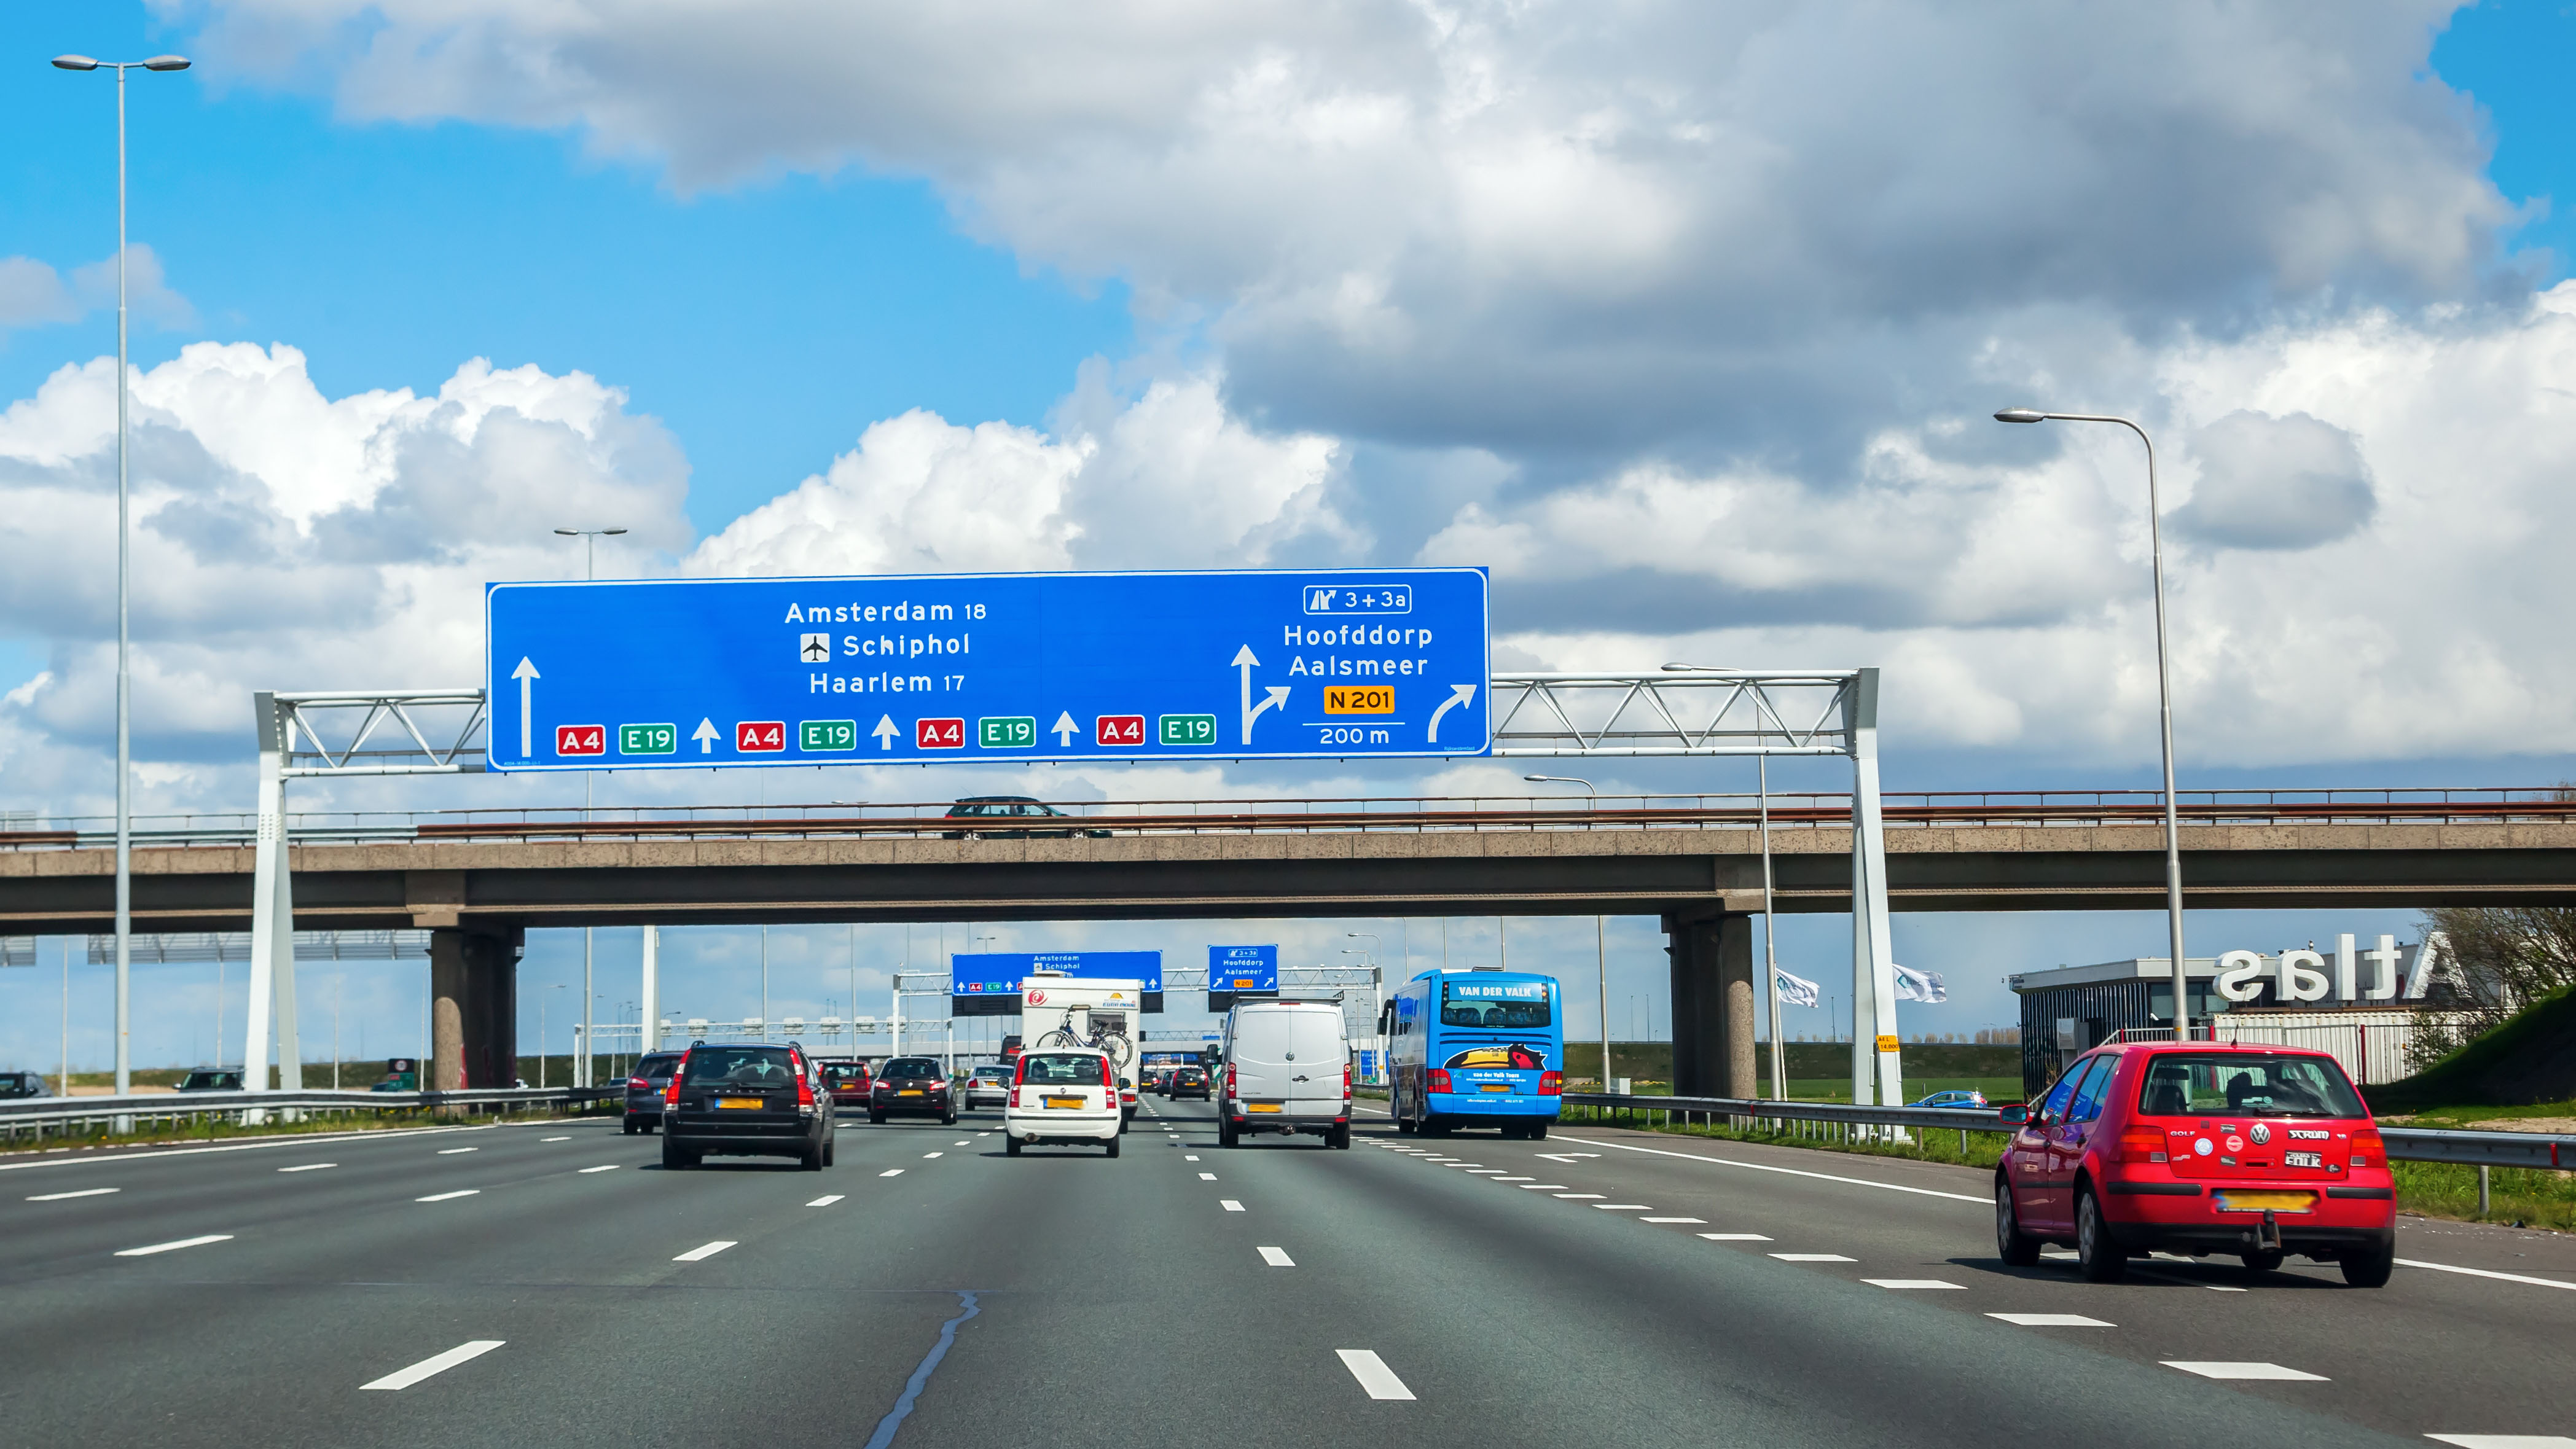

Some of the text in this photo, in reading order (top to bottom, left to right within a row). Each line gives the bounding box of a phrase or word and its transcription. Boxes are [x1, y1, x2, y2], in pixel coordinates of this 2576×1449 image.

[1345, 592, 1357, 607] 3
[1381, 591, 1406, 607] 3a
[785, 600, 987, 623] Amsterdam 18
[843, 633, 969, 659] Schiphol
[1285, 624, 1432, 649] Hoofddorp
[1289, 655, 1428, 676] Aalsmeer
[810, 671, 965, 693] Haarlem 17
[1351, 691, 1388, 708] 201
[628, 730, 670, 748] E19
[743, 727, 780, 746] A4
[808, 726, 850, 744] E19
[923, 724, 960, 743] A4
[988, 723, 1030, 741] E19
[1103, 721, 1140, 740] A4
[1169, 721, 1210, 738] E19
[1320, 728, 1389, 744] 200 m
[562, 731, 600, 750] A4
[1458, 986, 1532, 997] VAN DER VALK
